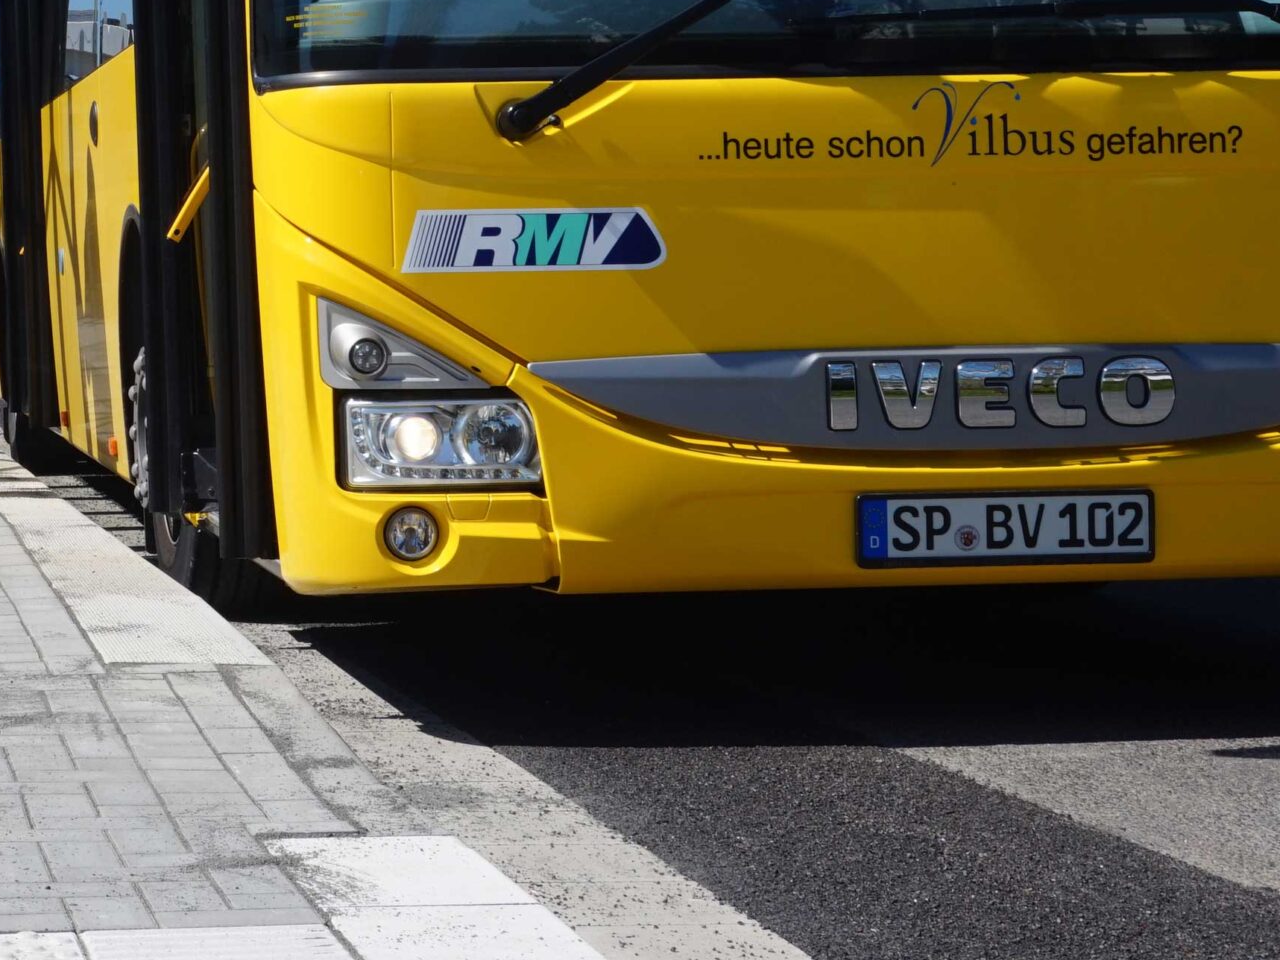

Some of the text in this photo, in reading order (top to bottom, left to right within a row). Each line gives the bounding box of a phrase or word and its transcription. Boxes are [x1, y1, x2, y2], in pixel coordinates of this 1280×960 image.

[698, 82, 1245, 167] ...heute schon Vilbus gefahren?
[454, 212, 638, 267] RMV
[825, 354, 1176, 432] IVECO
[870, 501, 1145, 552] D SP BV 102
